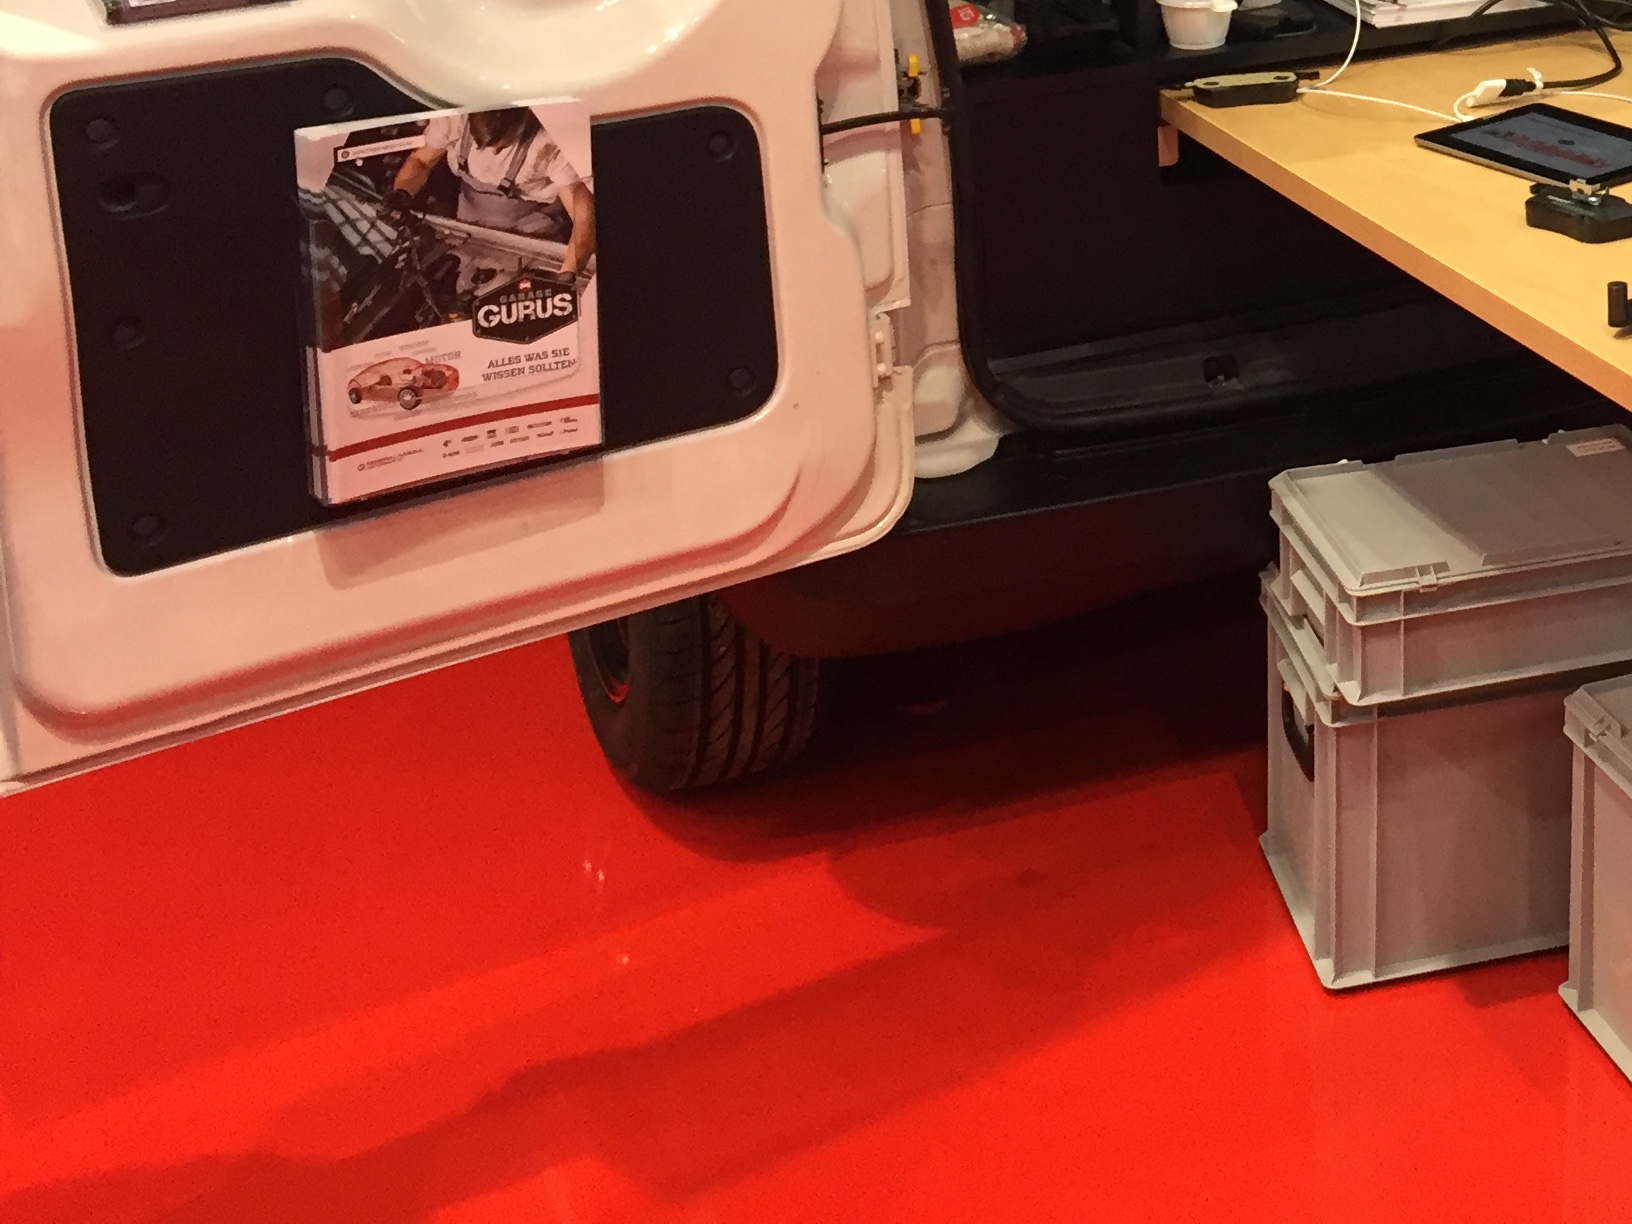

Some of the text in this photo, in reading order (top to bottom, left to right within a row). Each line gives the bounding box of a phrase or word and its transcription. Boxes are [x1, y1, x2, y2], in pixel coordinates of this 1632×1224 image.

[477, 293, 573, 328] GURUS
[482, 358, 577, 382] WISSEN SOLLTEN
[487, 347, 570, 369] ALLES WAS SIE
